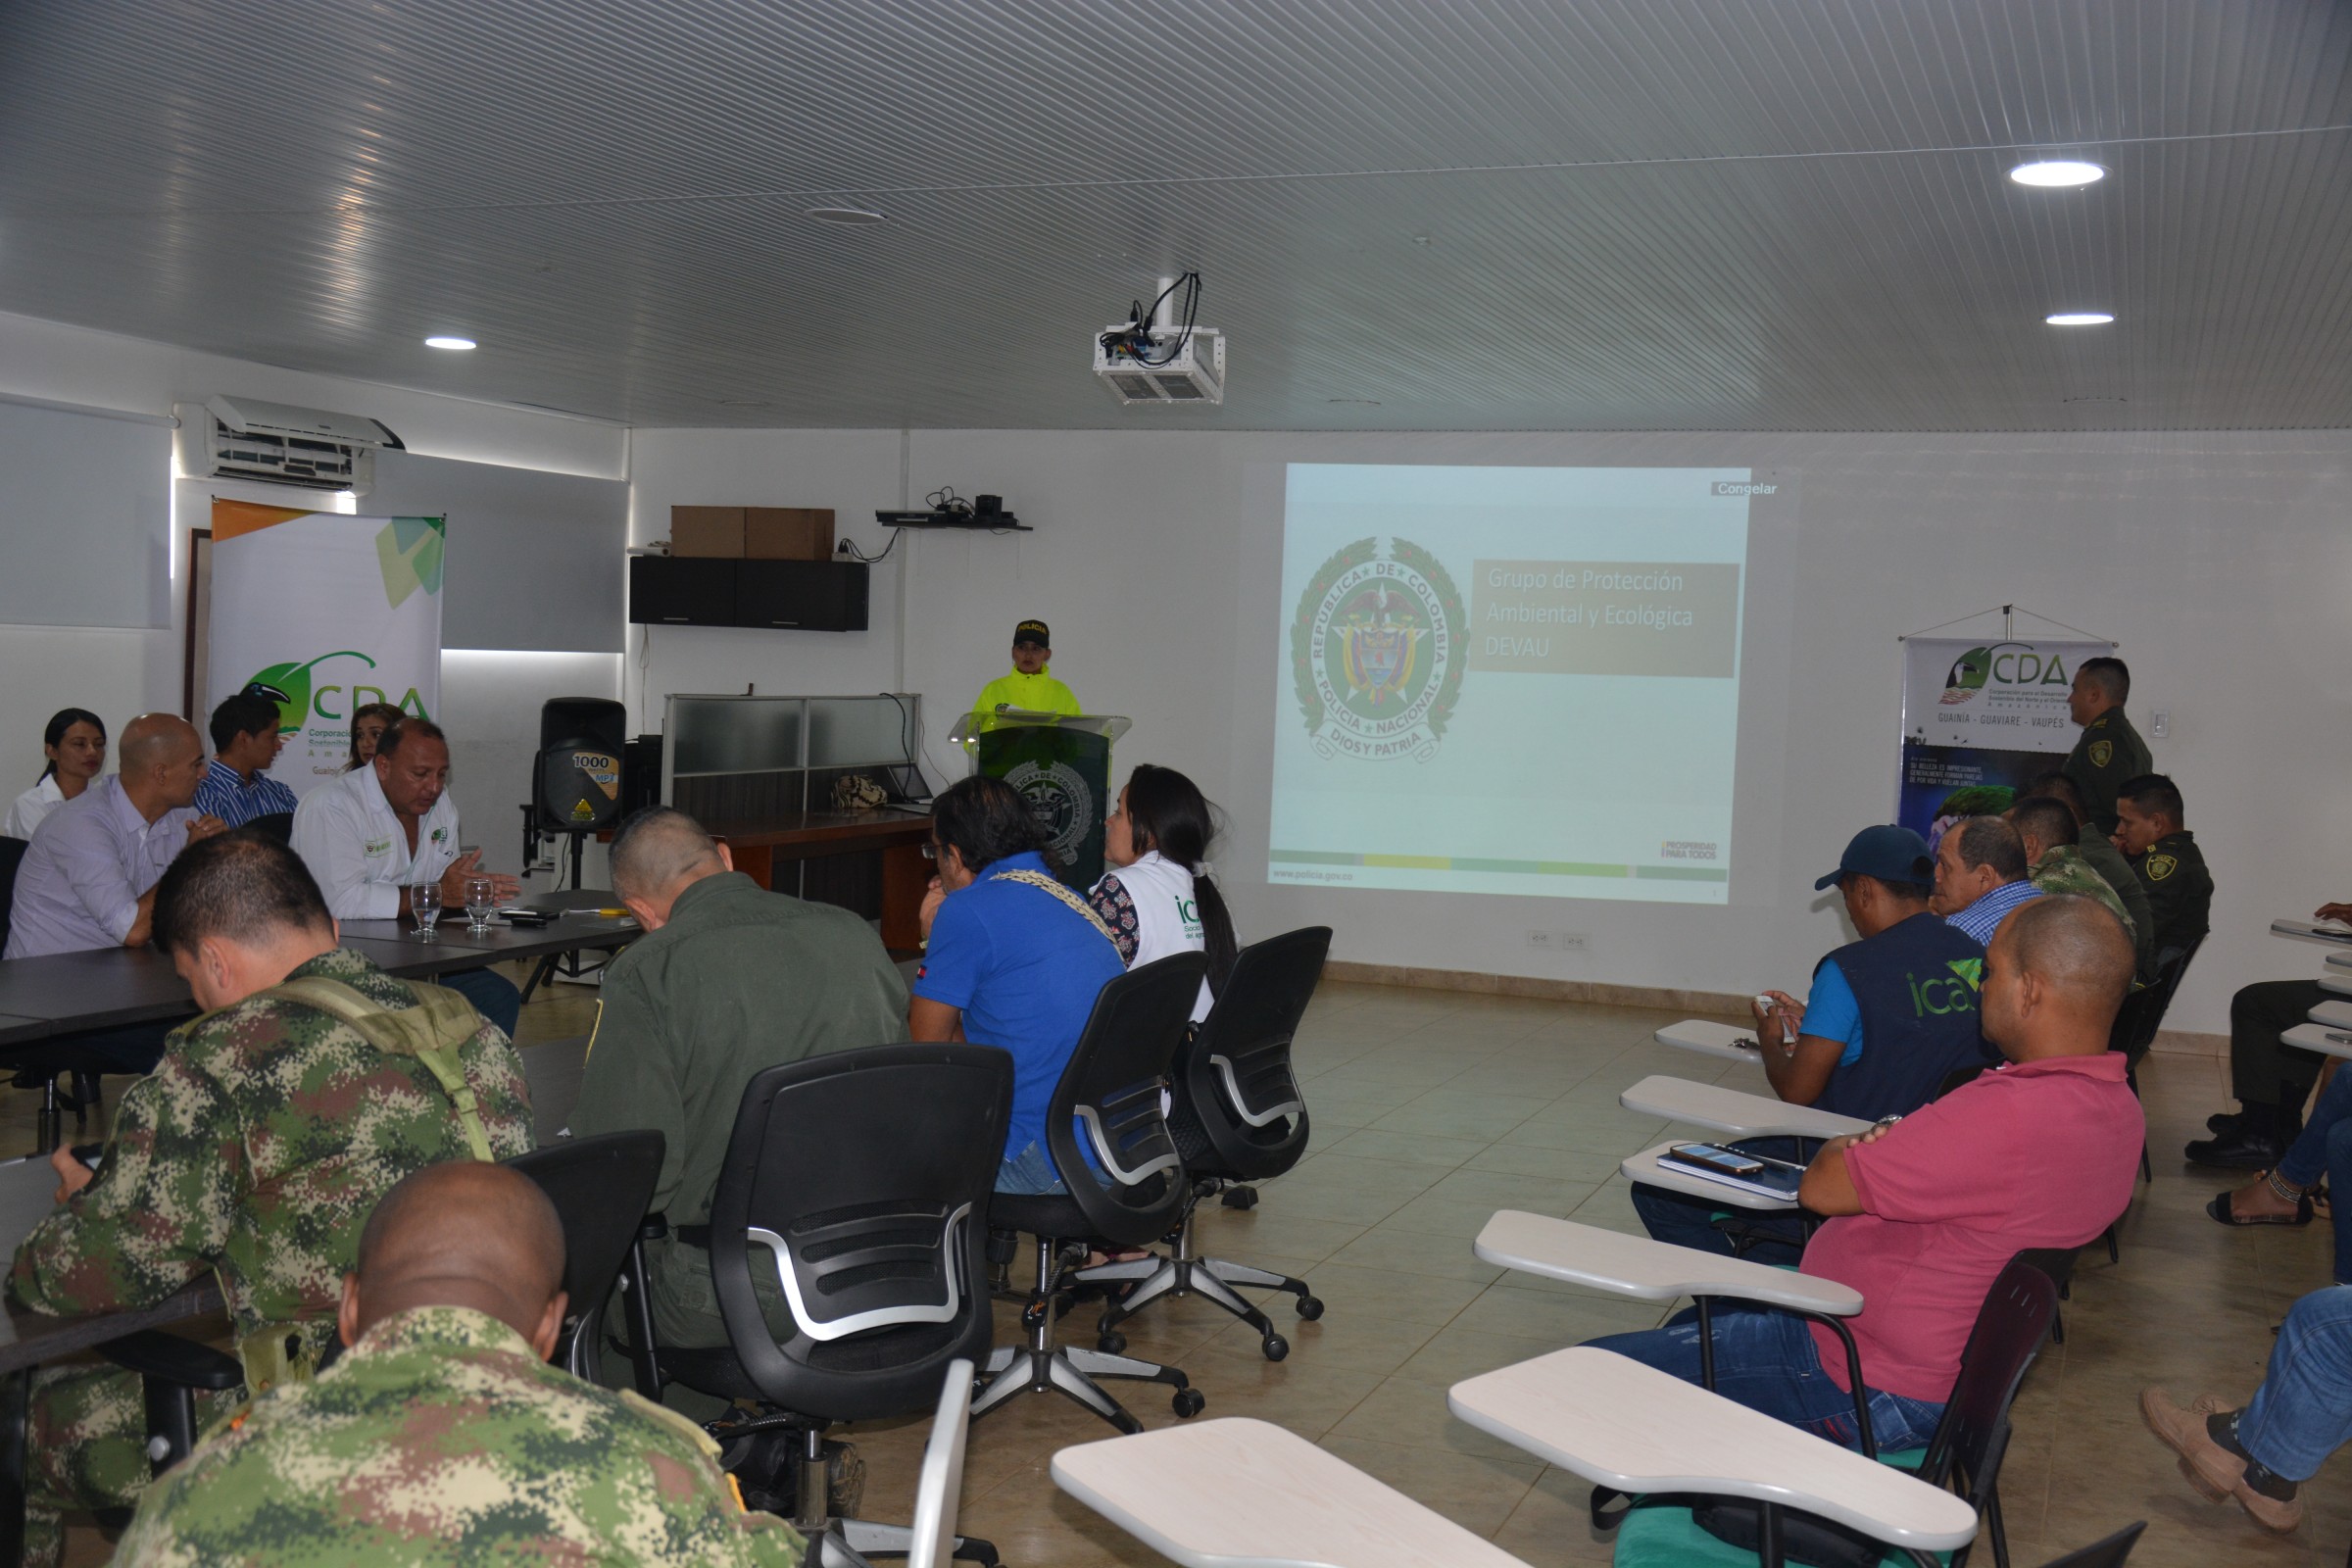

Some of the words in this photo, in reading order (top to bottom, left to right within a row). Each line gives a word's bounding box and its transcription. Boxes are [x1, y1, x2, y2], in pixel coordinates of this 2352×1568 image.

[1718, 482, 1778, 496] Congelar
[1489, 568, 1547, 593] Grupo
[1553, 568, 1576, 589] de
[1583, 569, 1684, 592] Protección
[1313, 570, 1362, 660] REPUBLICA
[1376, 563, 1396, 576] DE
[1407, 574, 1446, 664] COLOMBIA
[1486, 602, 1583, 624] Ambiental
[1589, 609, 1599, 629] y
[1605, 604, 1693, 631] Ecológica
[1486, 636, 1550, 658] DEVAU
[1993, 654, 2068, 685] CDA
[1318, 679, 1361, 731] POLICIA
[1376, 683, 1439, 735] NACIONAL
[1938, 712, 1970, 722] GUAINÍA
[1980, 714, 2021, 726] GUAVIARE
[2032, 716, 2064, 728] VAUPÉS
[1330, 728, 1362, 753] DIOS
[1363, 744, 1371, 756] Y
[1374, 732, 1422, 756] PATRIA
[573, 756, 609, 768] 1000
[1689, 851, 1717, 860] TODOS
[1273, 870, 1353, 881] www.policia.gov.co
[1175, 895, 1200, 924] ic
[1906, 972, 1976, 1017] ica
